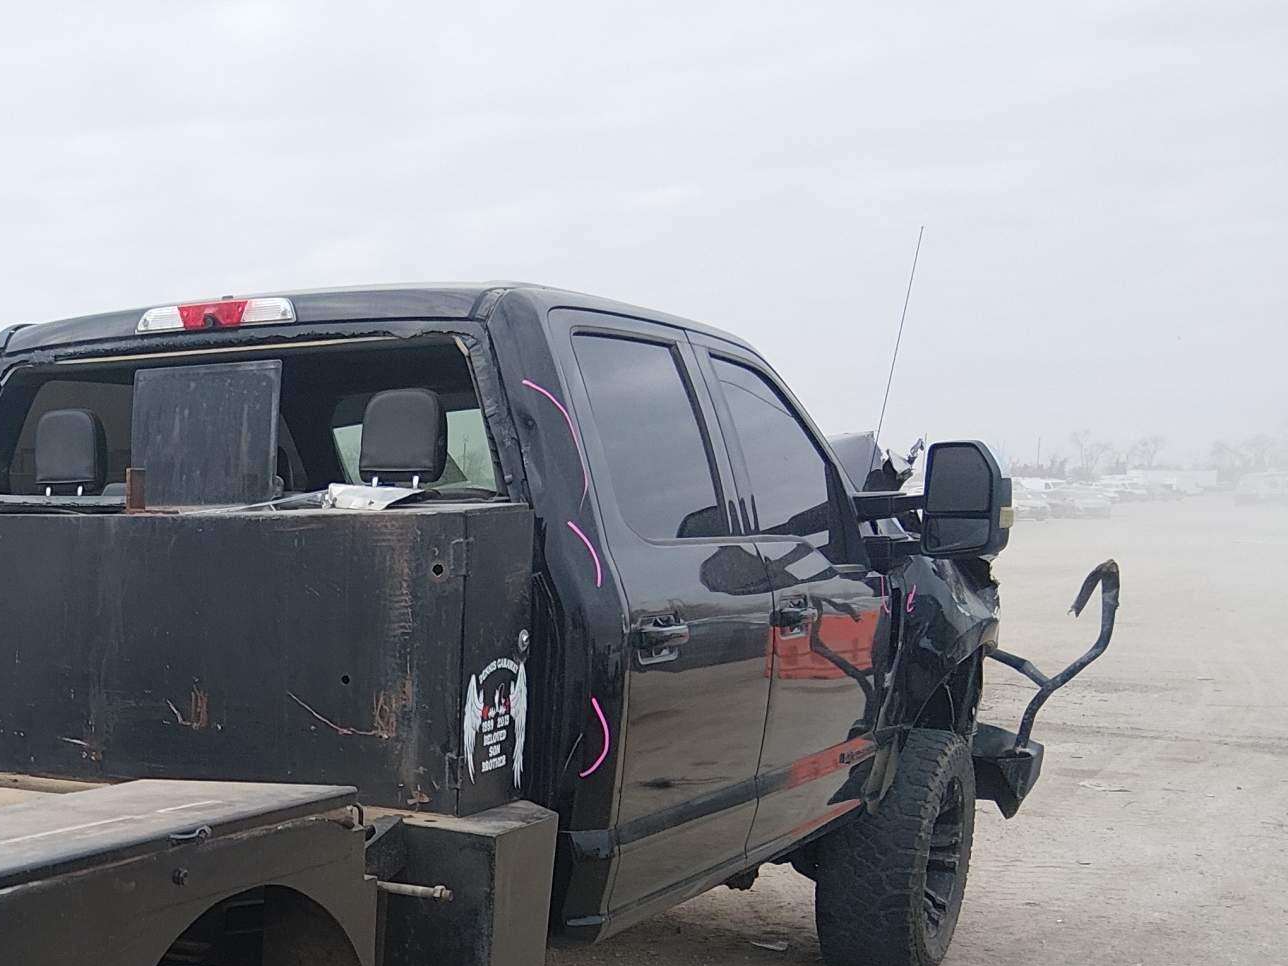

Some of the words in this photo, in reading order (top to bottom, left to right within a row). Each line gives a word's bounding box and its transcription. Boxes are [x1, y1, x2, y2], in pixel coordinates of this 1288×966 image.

[483, 729, 507, 747] BELOVED
[488, 743, 501, 758] SON
[481, 754, 507, 773] BROTHER
